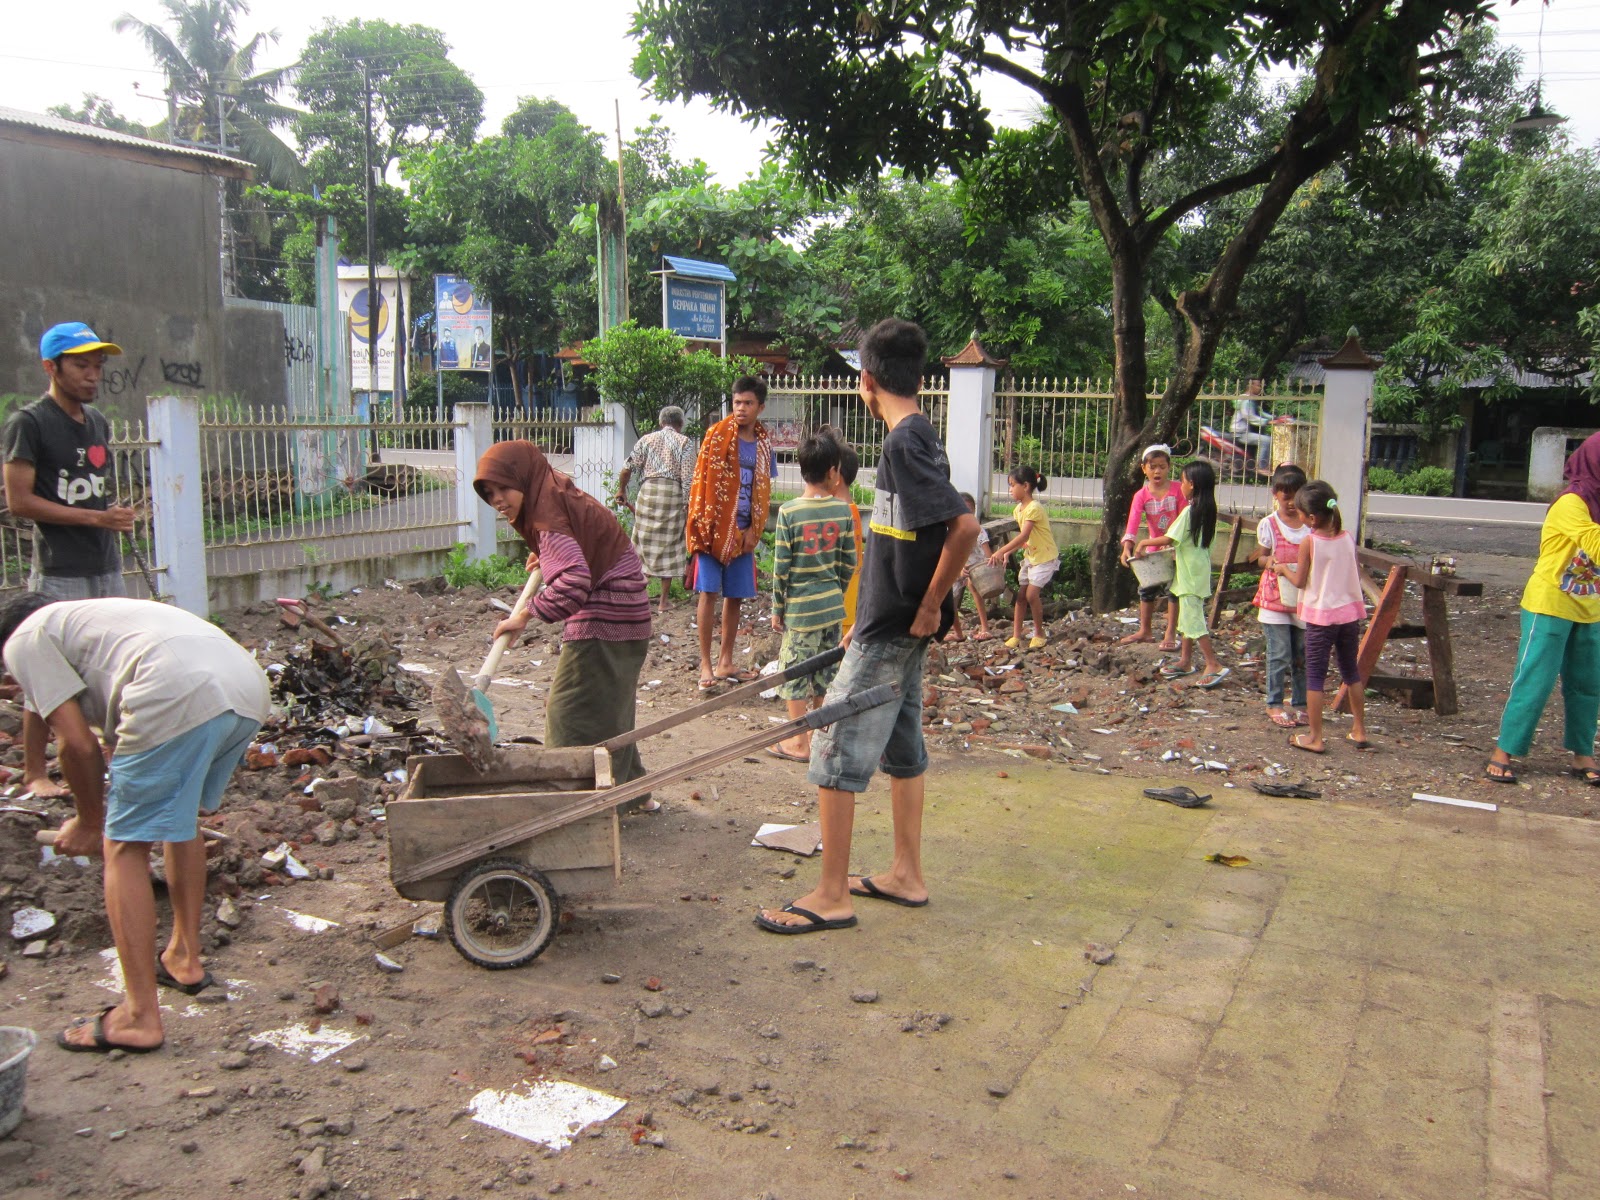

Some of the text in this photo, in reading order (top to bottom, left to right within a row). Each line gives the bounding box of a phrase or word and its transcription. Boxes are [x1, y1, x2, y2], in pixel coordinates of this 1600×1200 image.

[672, 299, 716, 314] CEMPAKA INDAH
[76, 447, 86, 467] I
[802, 521, 840, 555] 59
